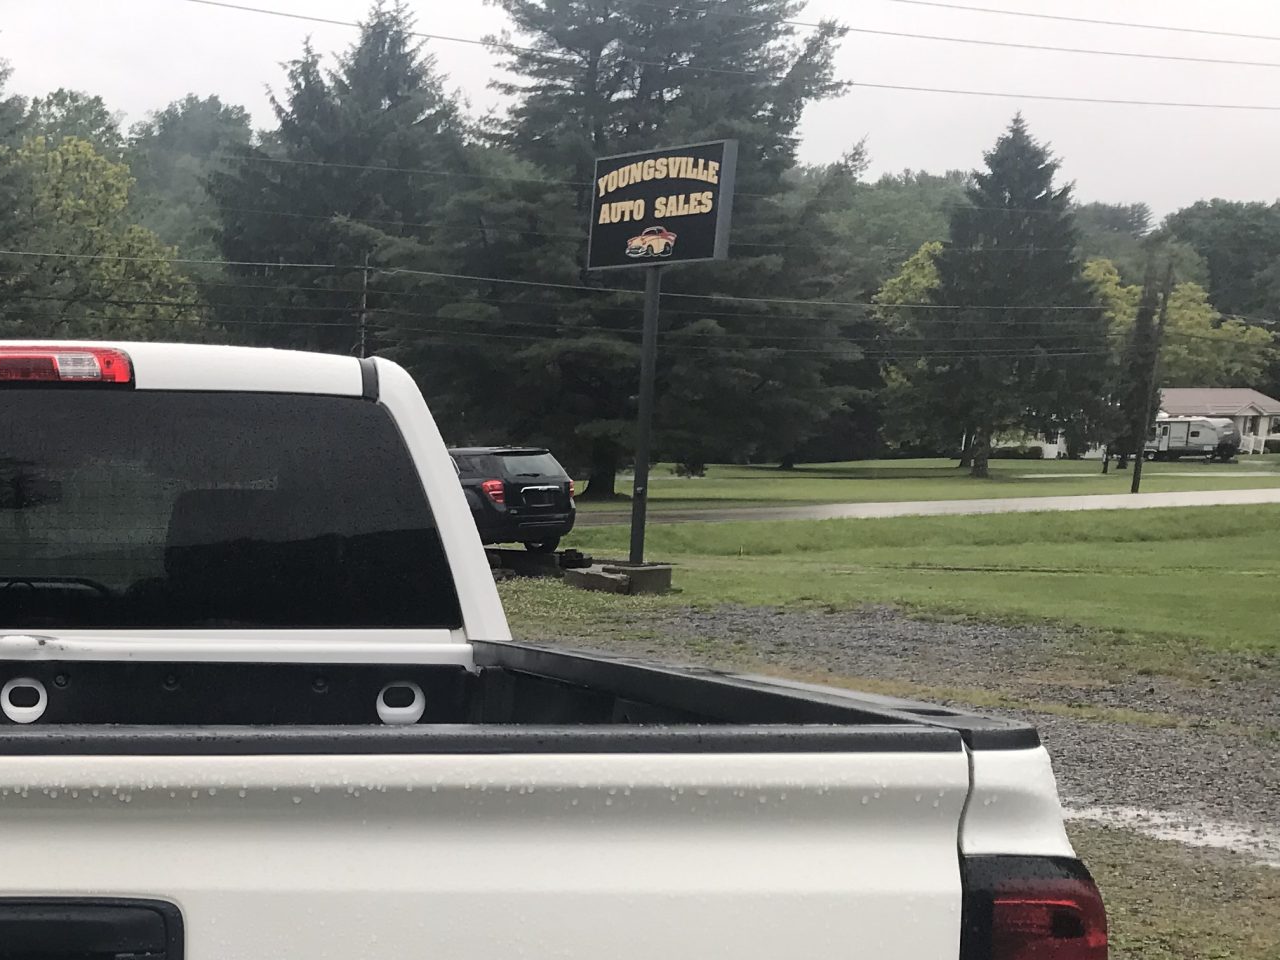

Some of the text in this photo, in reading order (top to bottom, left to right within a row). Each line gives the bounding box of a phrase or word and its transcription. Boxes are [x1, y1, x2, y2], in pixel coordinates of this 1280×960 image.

[598, 157, 720, 198] YOUNGSVILLE
[598, 191, 713, 225] AUTO SALES
